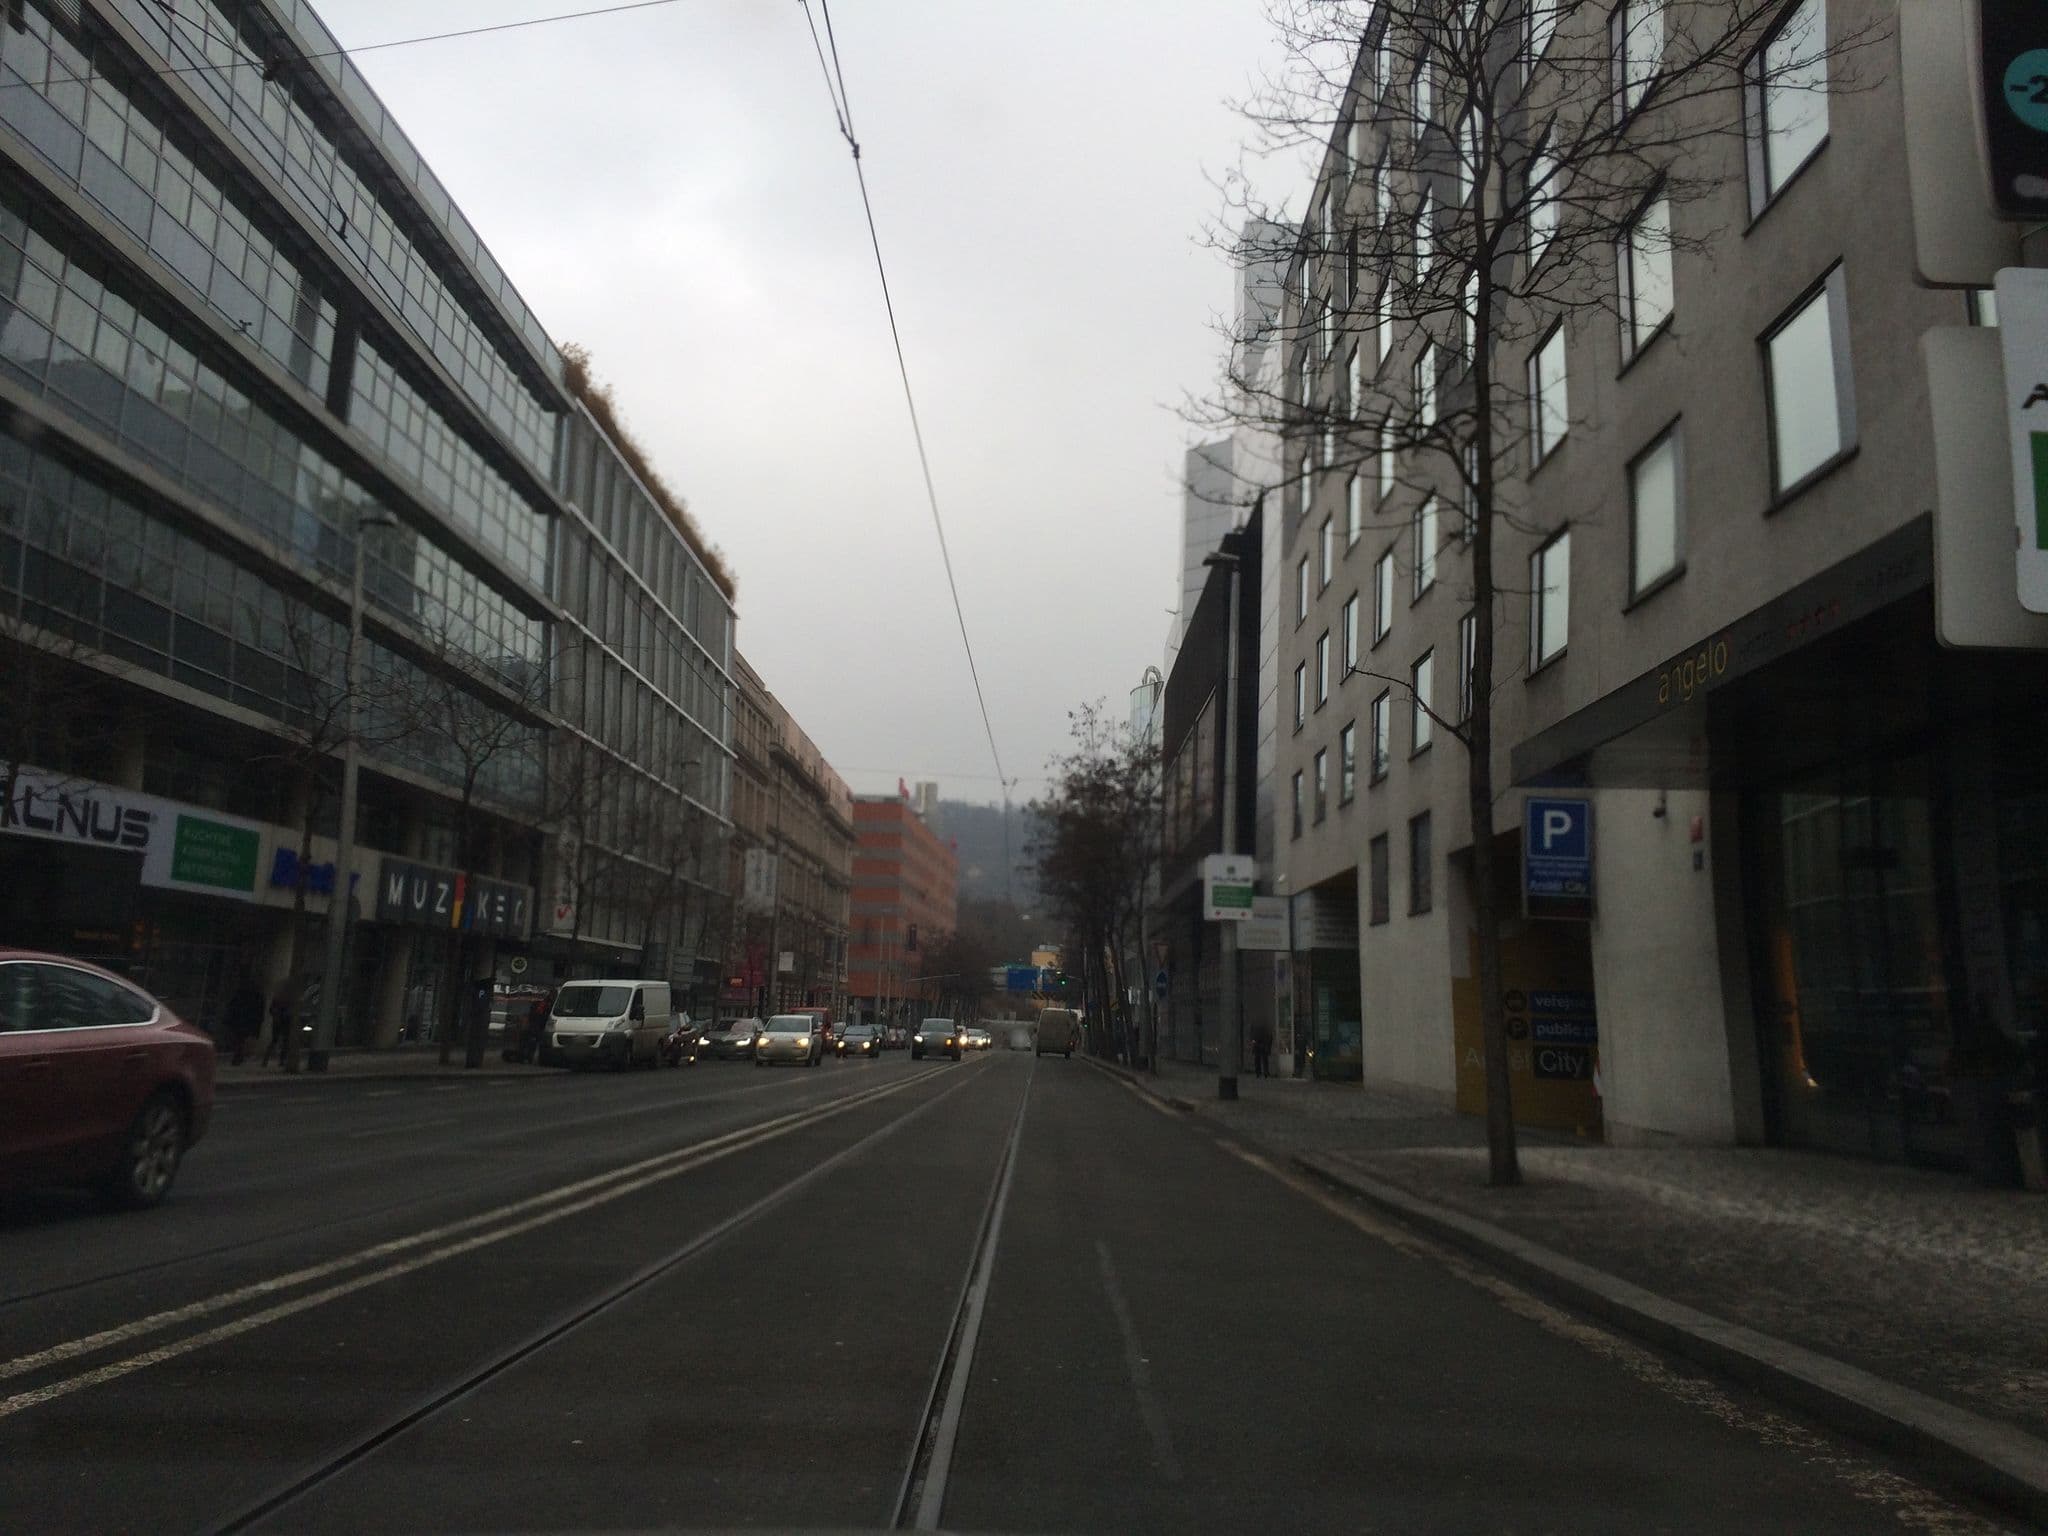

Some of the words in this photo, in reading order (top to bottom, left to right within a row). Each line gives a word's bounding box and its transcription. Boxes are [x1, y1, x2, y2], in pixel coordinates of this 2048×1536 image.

[1658, 638, 1728, 704] angelo
[1543, 809, 1573, 849] P
[1540, 1049, 1584, 1079] City
